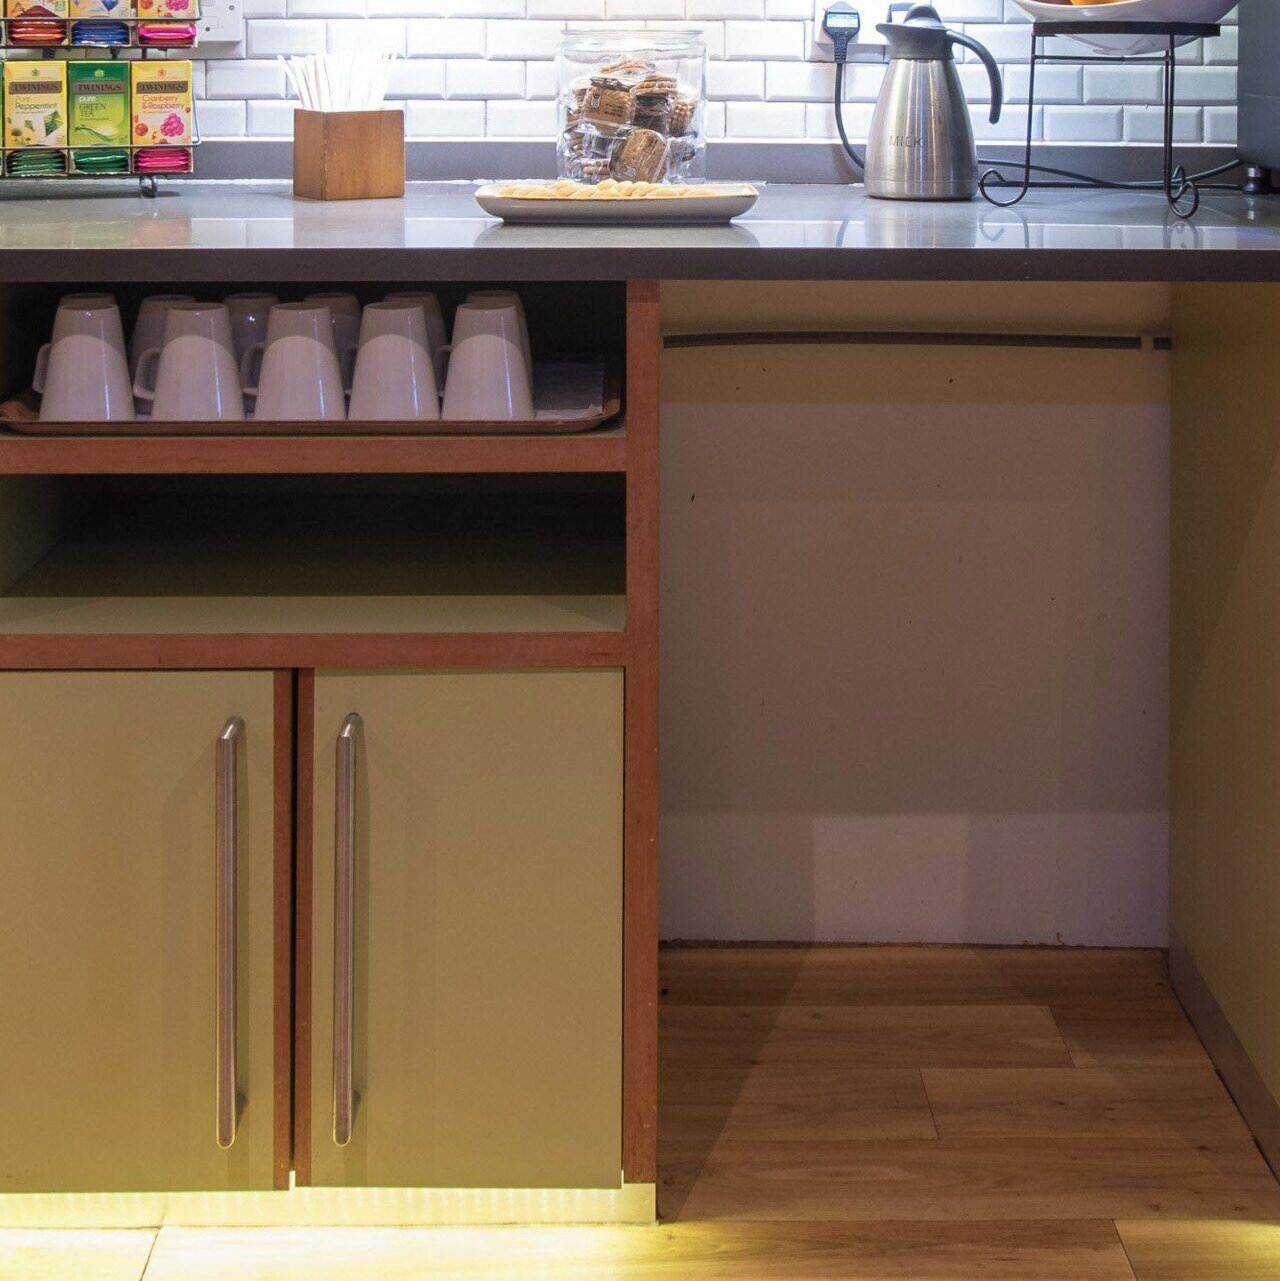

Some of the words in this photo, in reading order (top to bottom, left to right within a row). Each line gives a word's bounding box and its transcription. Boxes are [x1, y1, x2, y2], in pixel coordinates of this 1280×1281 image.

[14, 83, 59, 91] TWININGS
[78, 83, 122, 92] TWININGS
[140, 83, 185, 92] TWININGS
[143, 95, 179, 103] Cranberry
[16, 103, 58, 112] Peppermint
[888, 135, 922, 148] MILK
